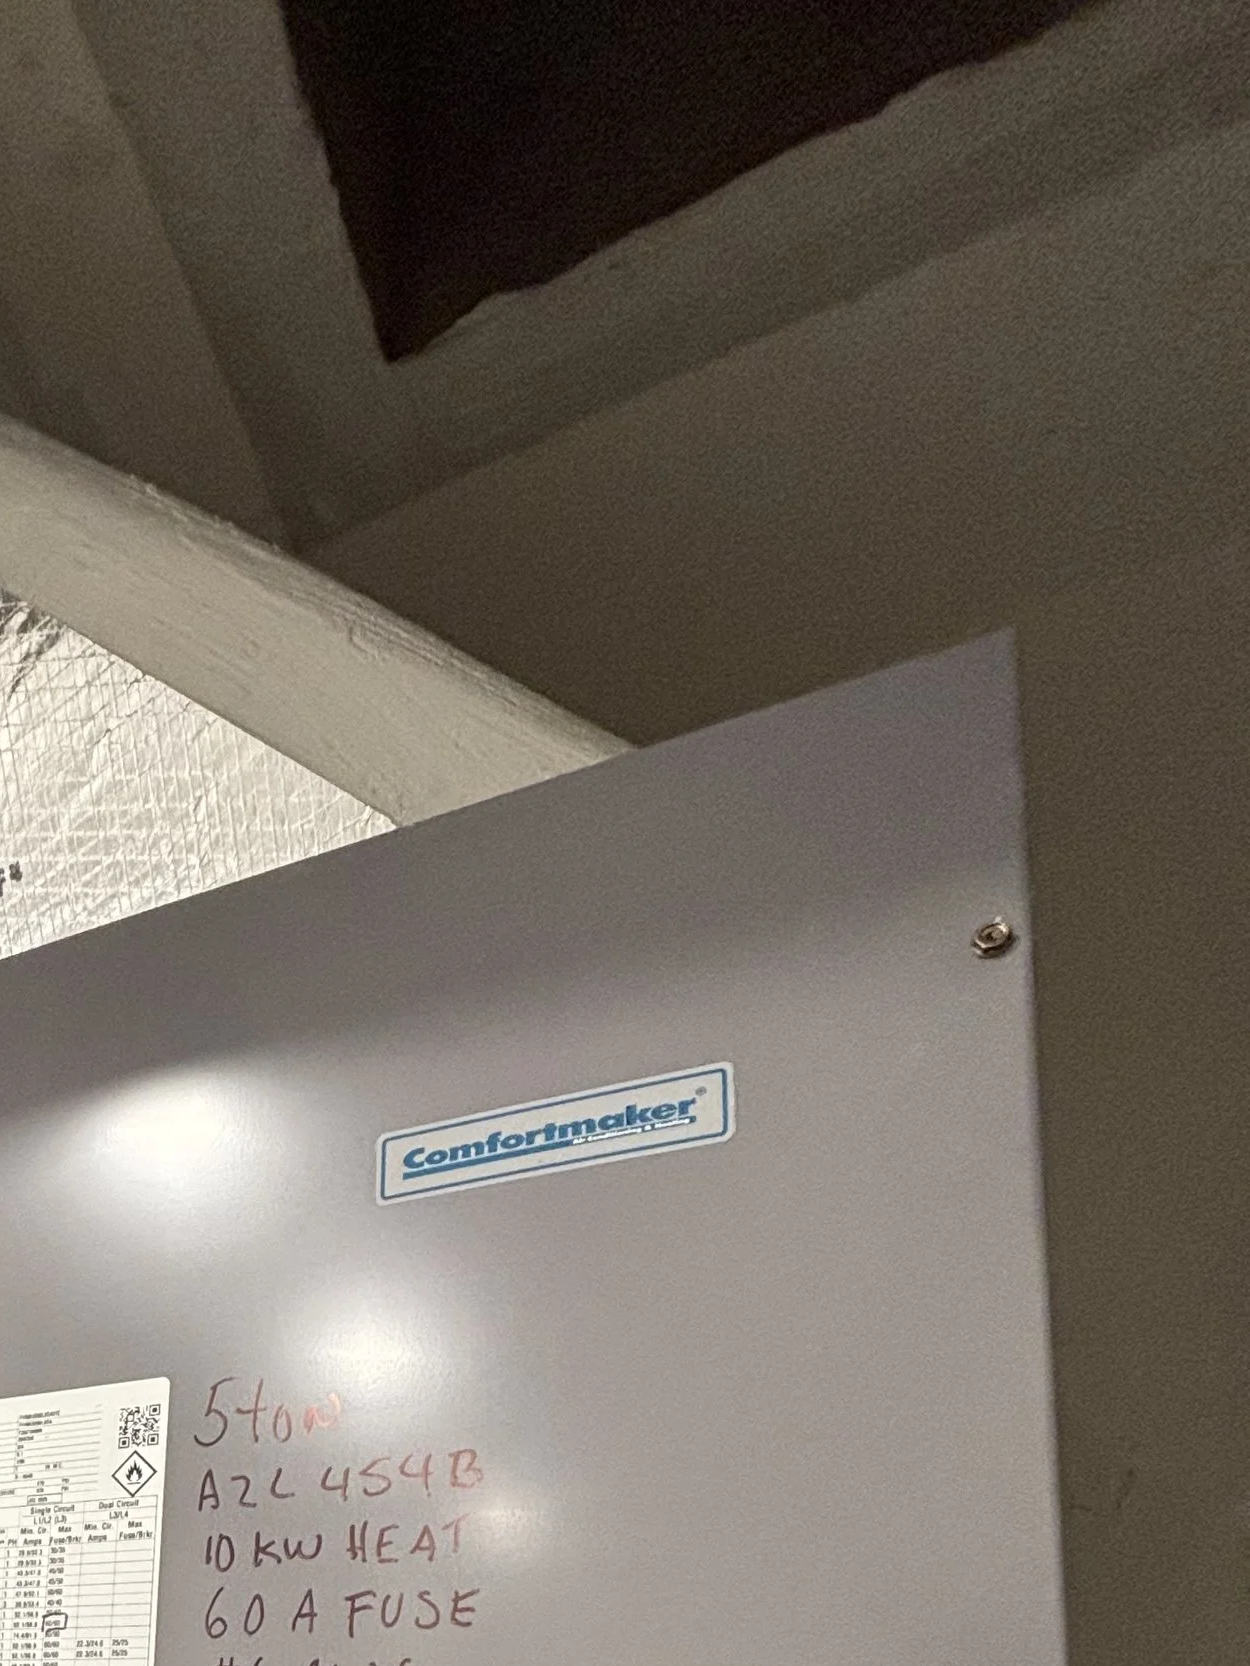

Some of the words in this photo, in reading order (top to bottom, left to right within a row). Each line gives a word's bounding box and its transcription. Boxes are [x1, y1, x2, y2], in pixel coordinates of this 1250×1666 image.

[403, 1096, 698, 1169] Comfortmaker
[205, 1533, 236, 1573] 10
[346, 1513, 472, 1563] HEAT
[205, 1586, 265, 1640] 60
[291, 1588, 318, 1633] A
[345, 1588, 480, 1639] FUSE
